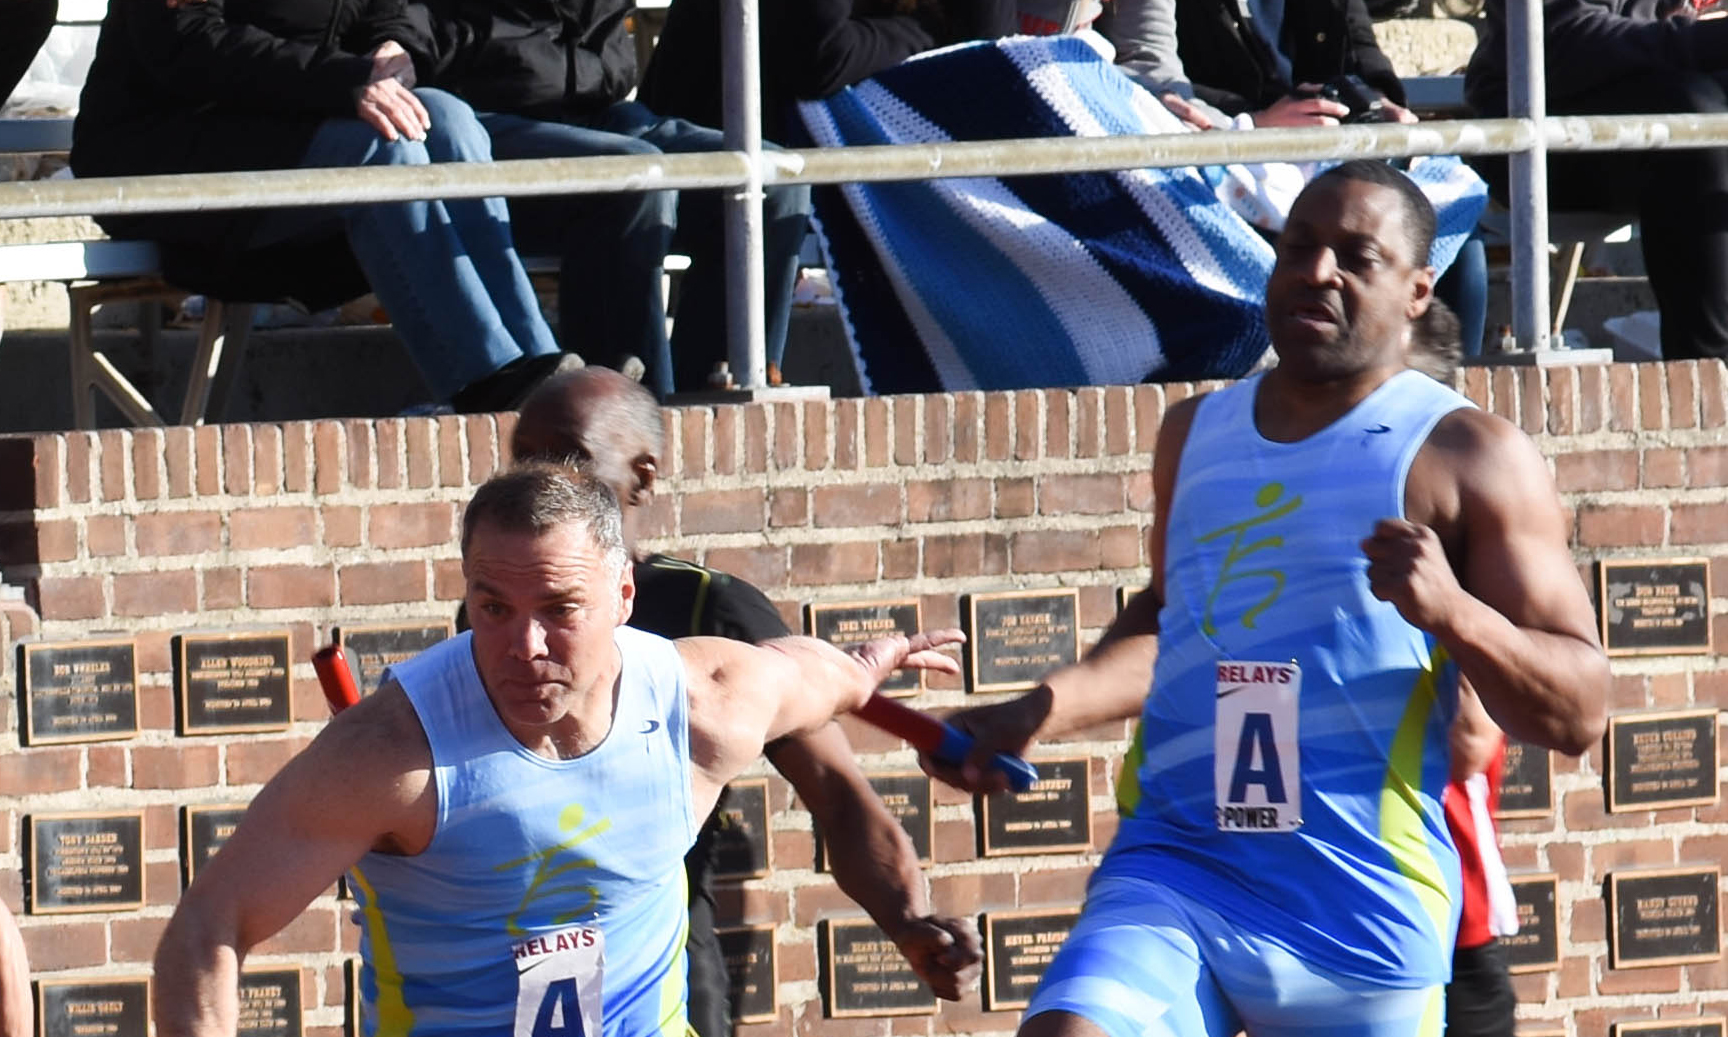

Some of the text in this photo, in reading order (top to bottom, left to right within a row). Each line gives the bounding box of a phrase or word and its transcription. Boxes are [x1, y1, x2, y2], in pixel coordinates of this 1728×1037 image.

[1216, 665, 1293, 684] RELAYS
[1228, 713, 1288, 804] A
[1223, 806, 1279, 829] POWER
